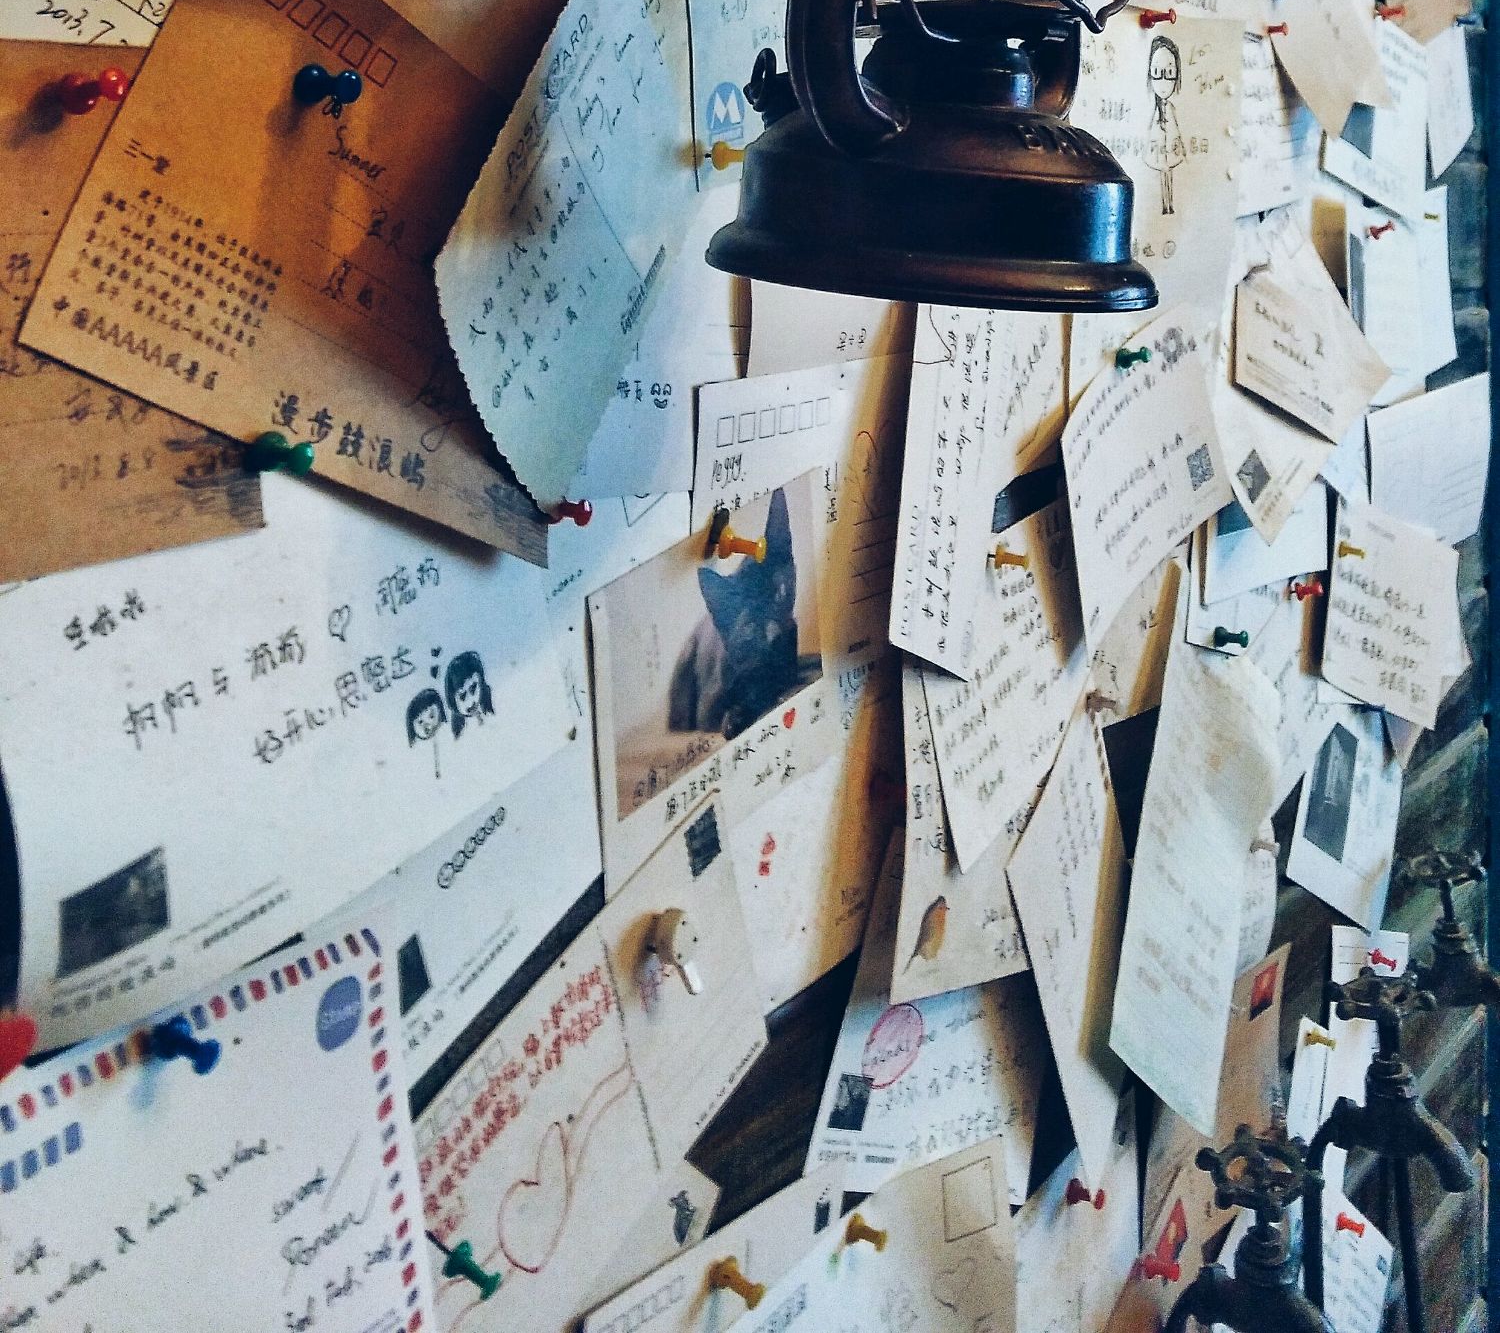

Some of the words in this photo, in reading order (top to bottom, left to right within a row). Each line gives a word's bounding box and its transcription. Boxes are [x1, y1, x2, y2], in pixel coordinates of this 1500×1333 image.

[271, 389, 428, 493] 漫步鼓浪屿
